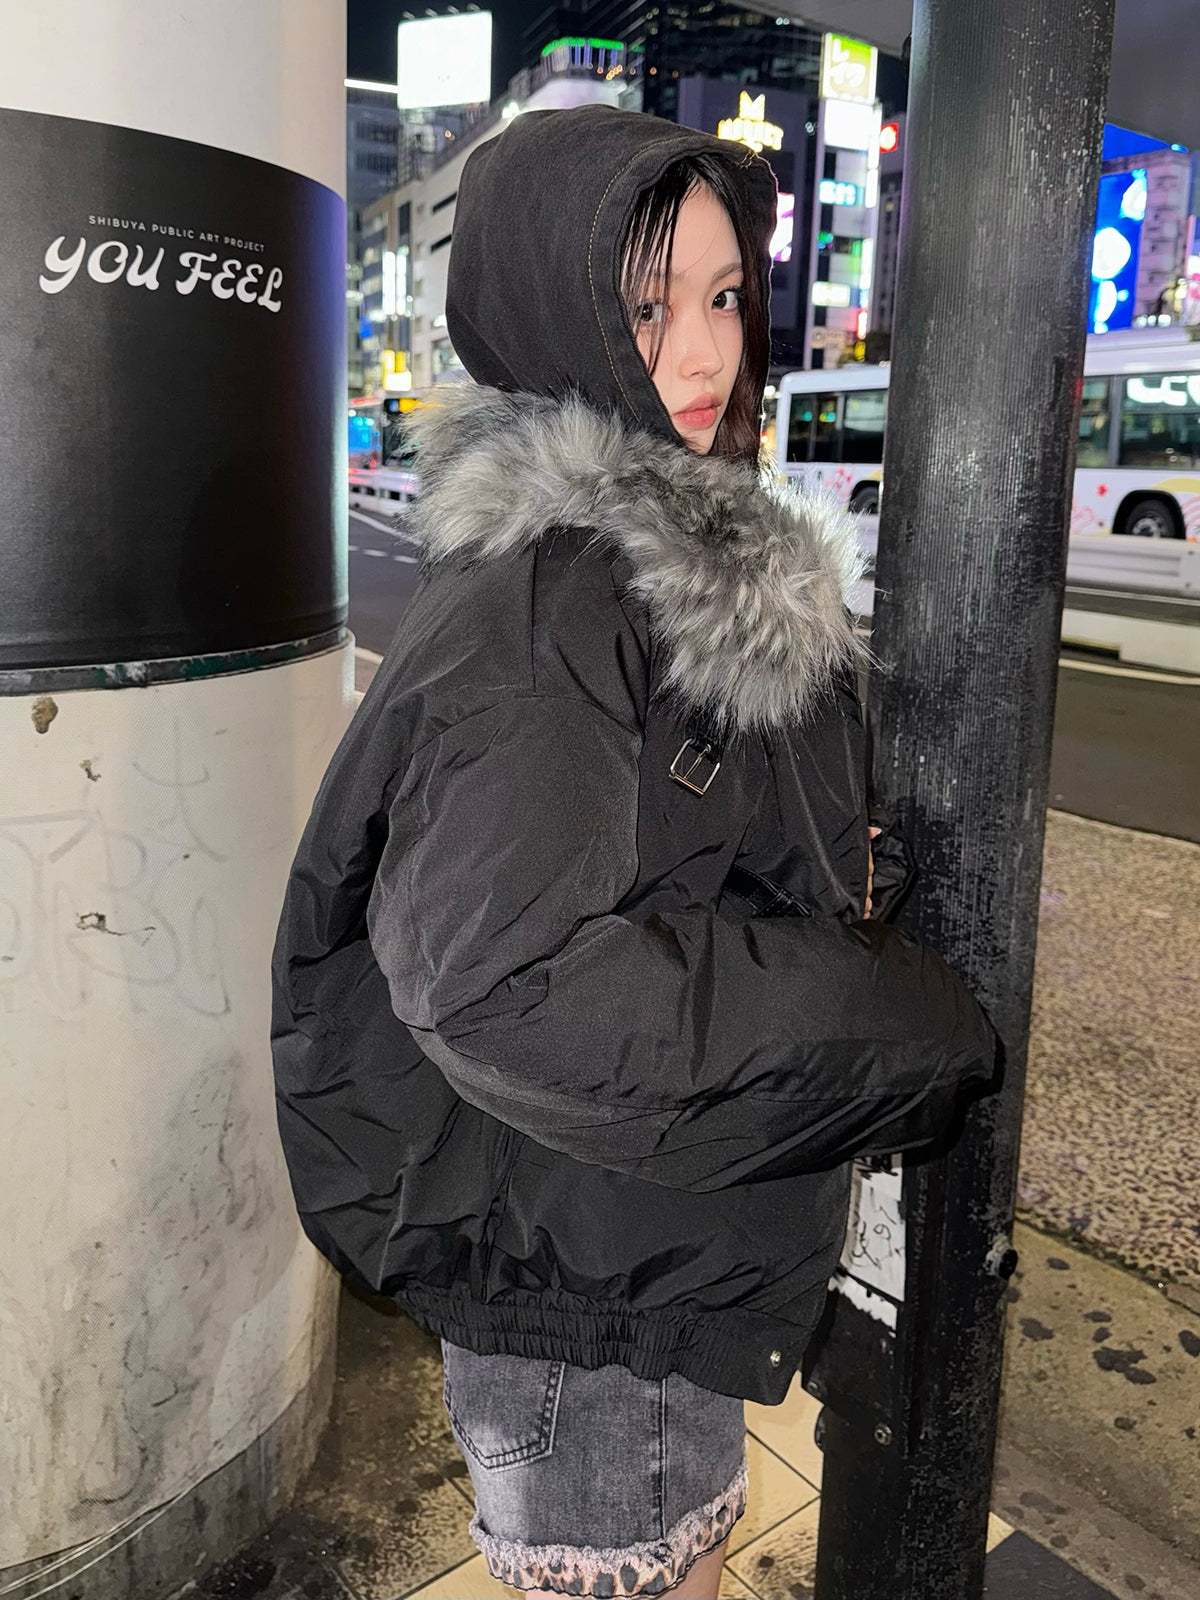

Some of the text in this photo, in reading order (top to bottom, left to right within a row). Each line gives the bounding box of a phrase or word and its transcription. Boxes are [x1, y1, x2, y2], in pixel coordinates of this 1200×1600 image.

[88, 215, 265, 252] SHIBUYA PUBLIC ART PROJECT
[38, 235, 283, 313] YOU FEEL
